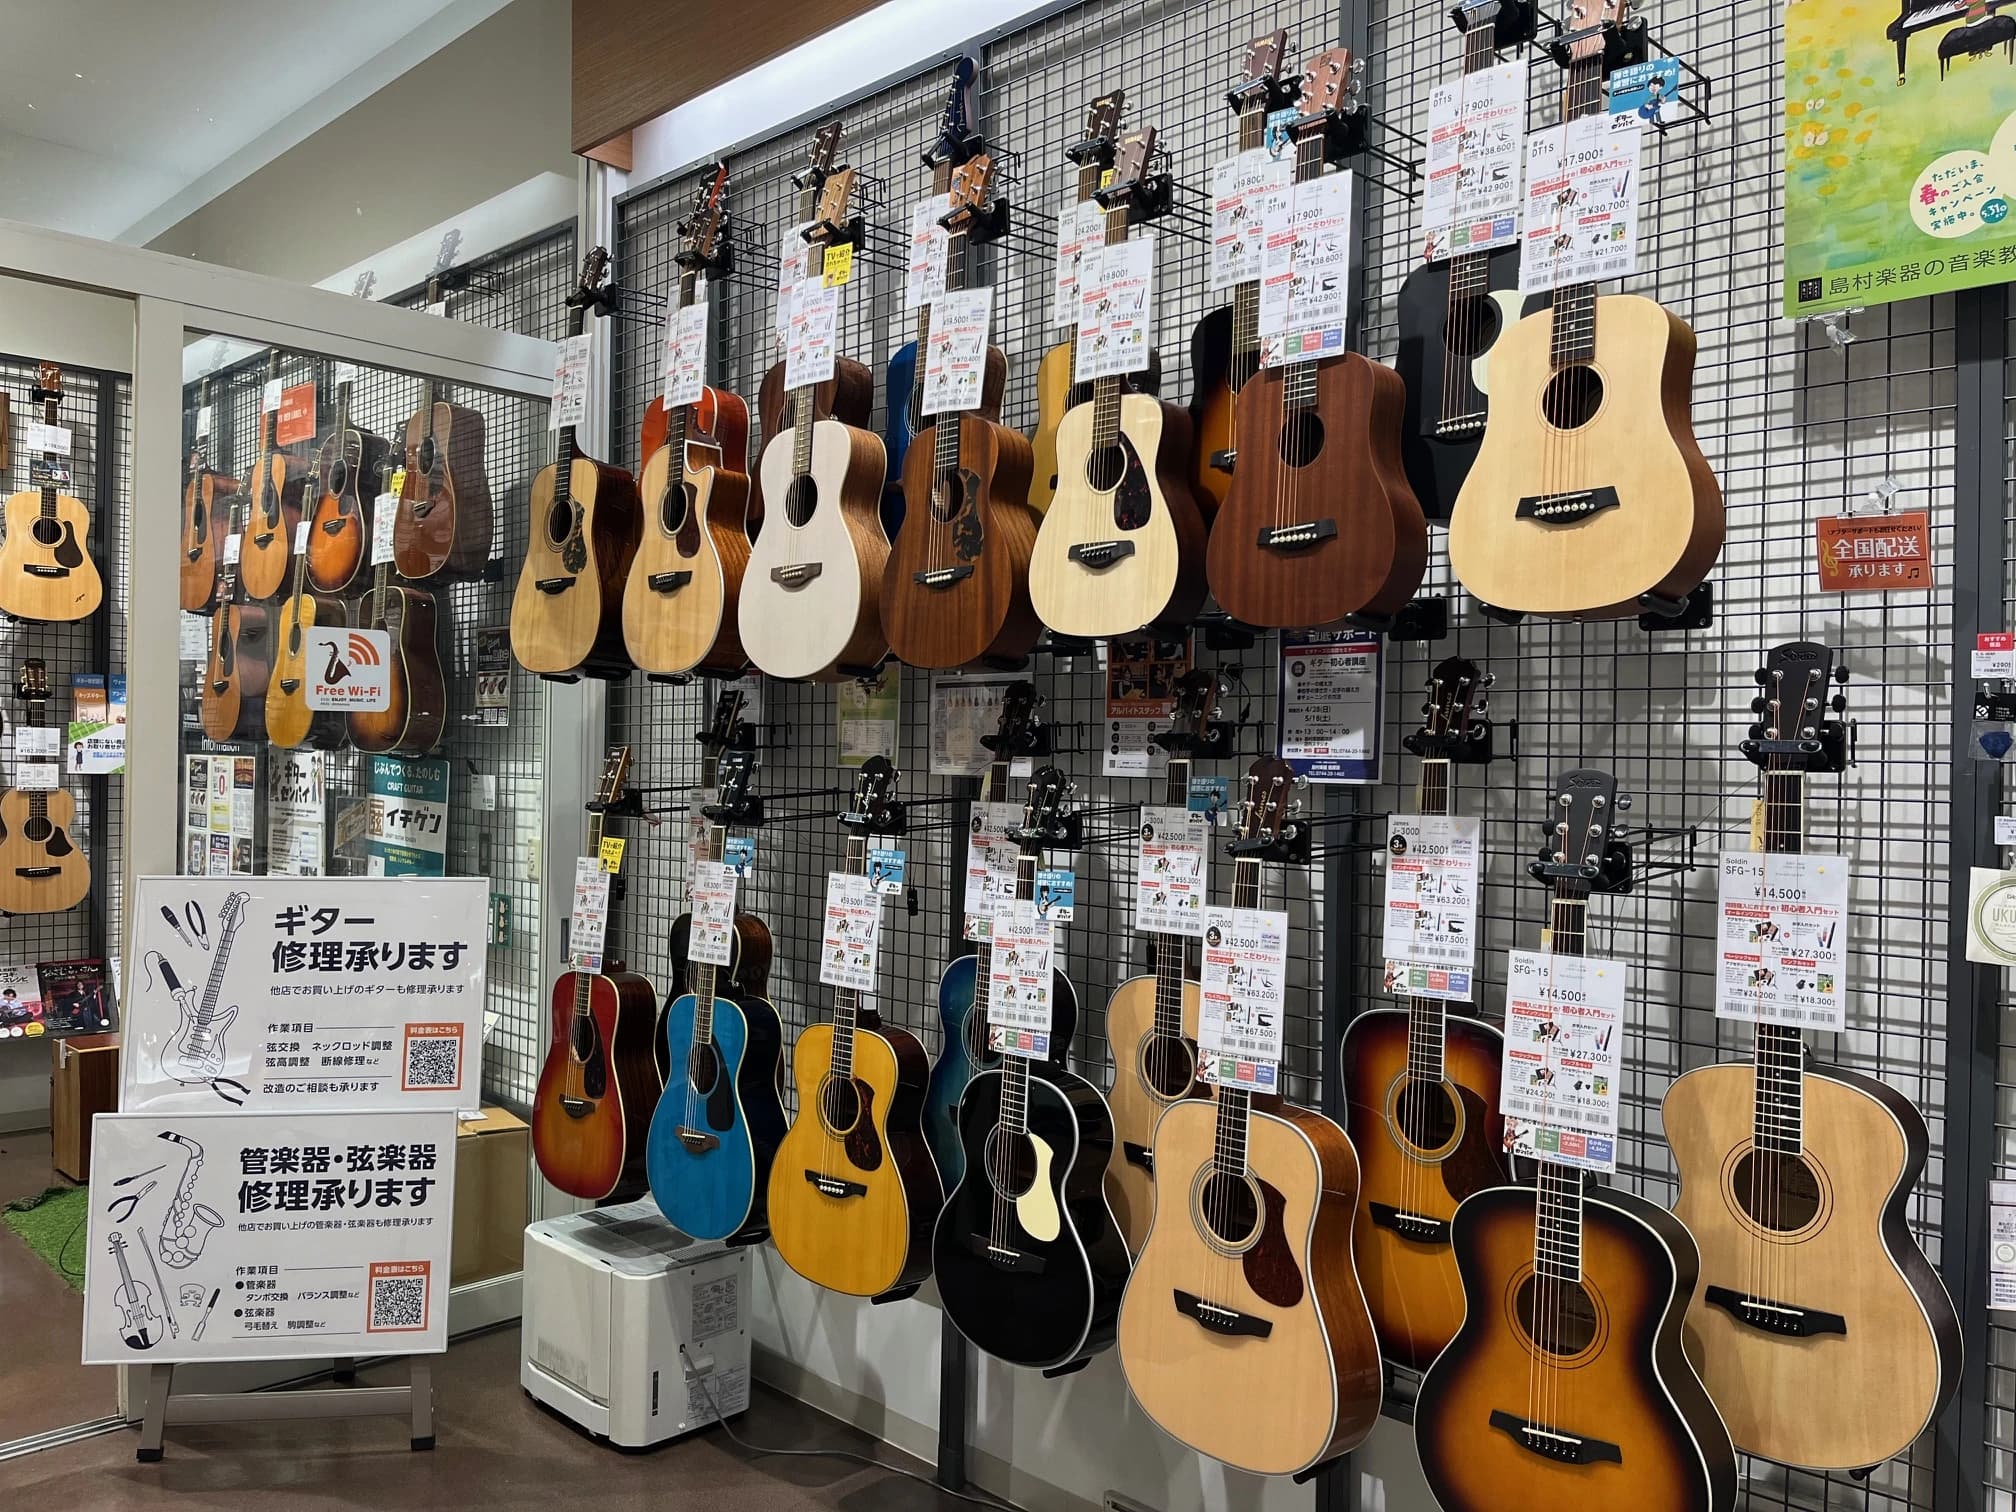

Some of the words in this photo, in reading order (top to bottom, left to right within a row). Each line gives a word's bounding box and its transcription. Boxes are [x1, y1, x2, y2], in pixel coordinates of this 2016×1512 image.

[1532, 143, 1554, 158] DT1S
[1920, 173, 1984, 205] 春のご入会
[1928, 186, 1996, 216] キャンペーン
[1829, 245, 2016, 296] 島村楽器の音楽教
[1832, 535, 1921, 559] 全国配送
[1848, 562, 1906, 578] 承ります
[315, 685, 345, 696] Free
[348, 686, 381, 697] Wi-Fi
[386, 806, 442, 834] イチゲン
[1725, 866, 1764, 876] SFG-15
[274, 906, 376, 937] ギター
[271, 940, 469, 973] 修理承ります
[1514, 957, 1534, 965] Soldin
[1513, 965, 1549, 977] SFG-15
[270, 984, 464, 996] 他店でお買い上げのギターも修理承ります
[267, 1023, 314, 1034] 作業項目
[266, 1041, 301, 1052] 弦交換
[312, 1040, 393, 1052] ネックロッド調整
[265, 1056, 310, 1067] 弦高調整
[321, 1055, 380, 1067] 断線修理など
[263, 1082, 380, 1094] 改造のご相談も承ります
[239, 1144, 437, 1175] 管楽器・弦楽器
[238, 1178, 436, 1213] 修理承ります
[238, 1217, 434, 1232] 他店でお買い上げの管楽器・弦楽器も修理承ります
[235, 1265, 279, 1276] 作業項目
[244, 1321, 279, 1331] 弓毛替え
